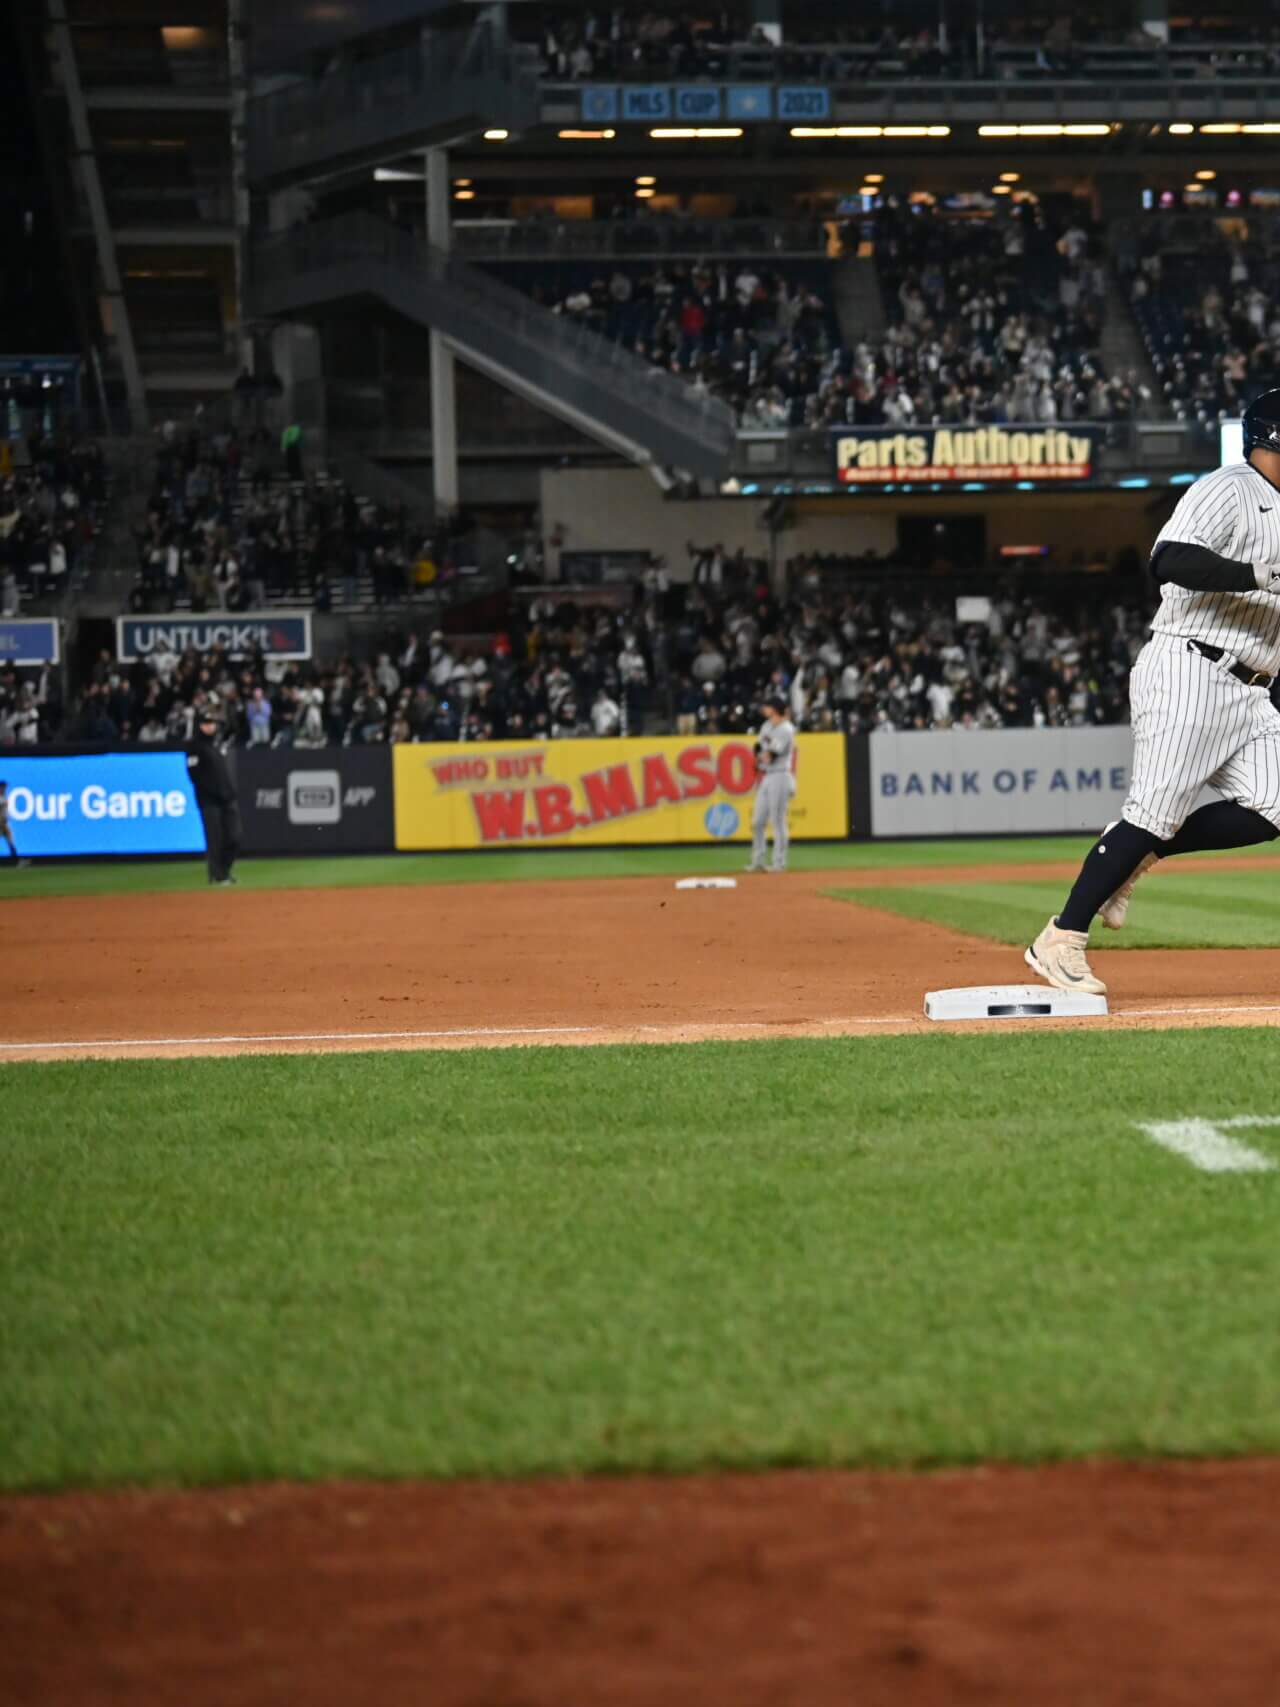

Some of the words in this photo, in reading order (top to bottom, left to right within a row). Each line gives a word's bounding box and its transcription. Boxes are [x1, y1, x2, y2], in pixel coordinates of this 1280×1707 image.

[627, 92, 665, 115] MLS
[680, 92, 719, 115] CUP
[837, 434, 928, 467] Parts
[932, 426, 1091, 466] Authority
[430, 758, 489, 785] WHO
[495, 752, 546, 779] BUT
[880, 770, 981, 797] BANK
[993, 768, 1037, 794] OF
[7, 787, 72, 821] Our
[79, 784, 187, 820] Game
